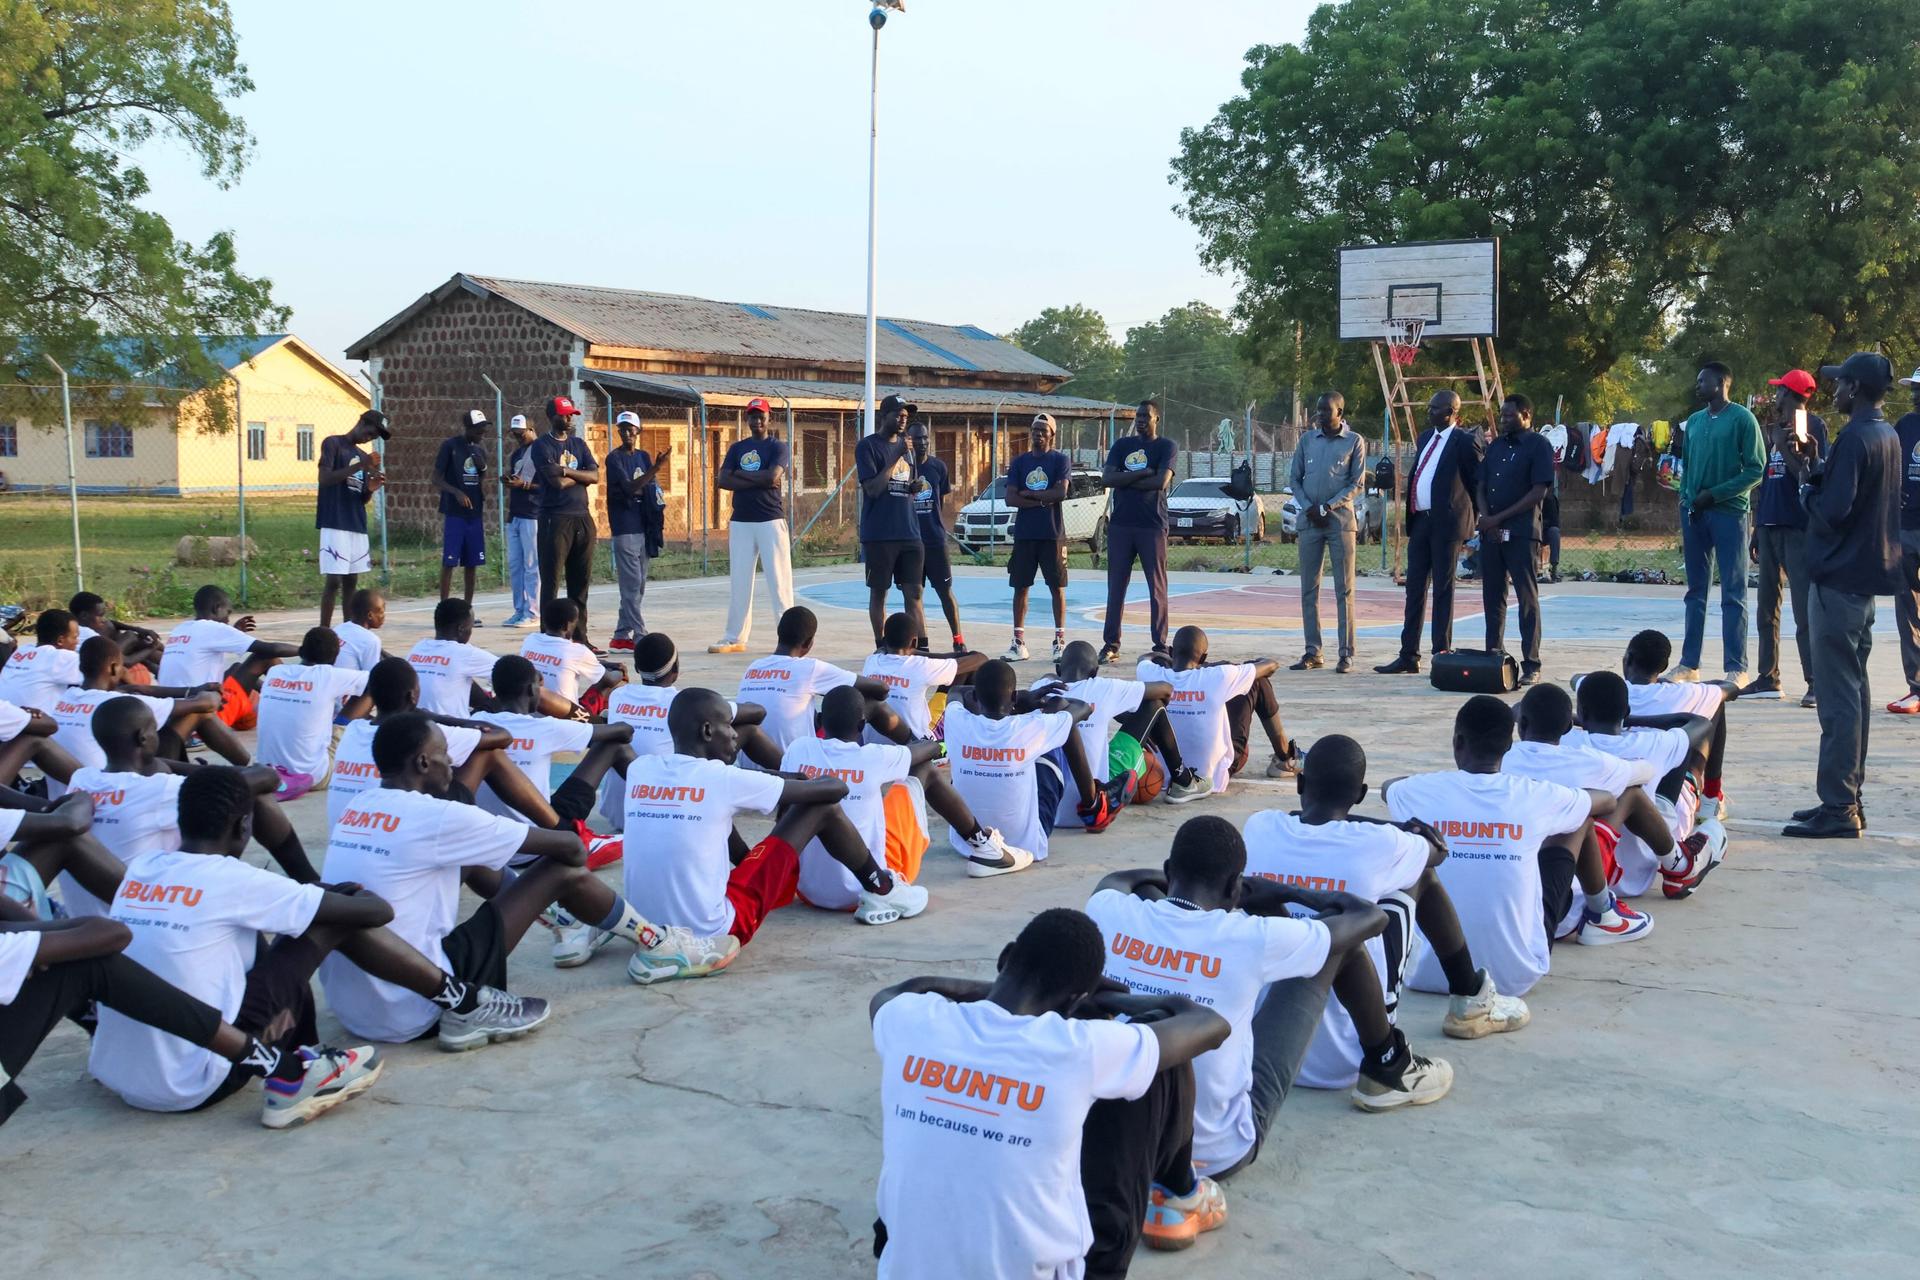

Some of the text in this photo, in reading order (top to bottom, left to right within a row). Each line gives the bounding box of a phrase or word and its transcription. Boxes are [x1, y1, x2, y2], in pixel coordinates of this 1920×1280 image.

[745, 669, 790, 680] UBUNTU
[1171, 690, 1205, 701] UNTU
[616, 703, 667, 718] UBUNTU
[962, 745, 1025, 761] UBUNTU
[334, 760, 381, 779] BUNT
[631, 784, 704, 802] UBUNTU
[637, 810, 669, 819] because
[1433, 820, 1523, 840] UBUNTU
[1452, 850, 1491, 860] because
[1509, 853, 1522, 861] are
[1252, 872, 1346, 892] UNTU
[1111, 932, 1221, 979] UBUNTU
[1123, 977, 1170, 996] because
[1194, 994, 1214, 1006] are
[902, 1054, 1045, 1111] UBUNTU
[895, 1104, 1032, 1148] I am because we are
